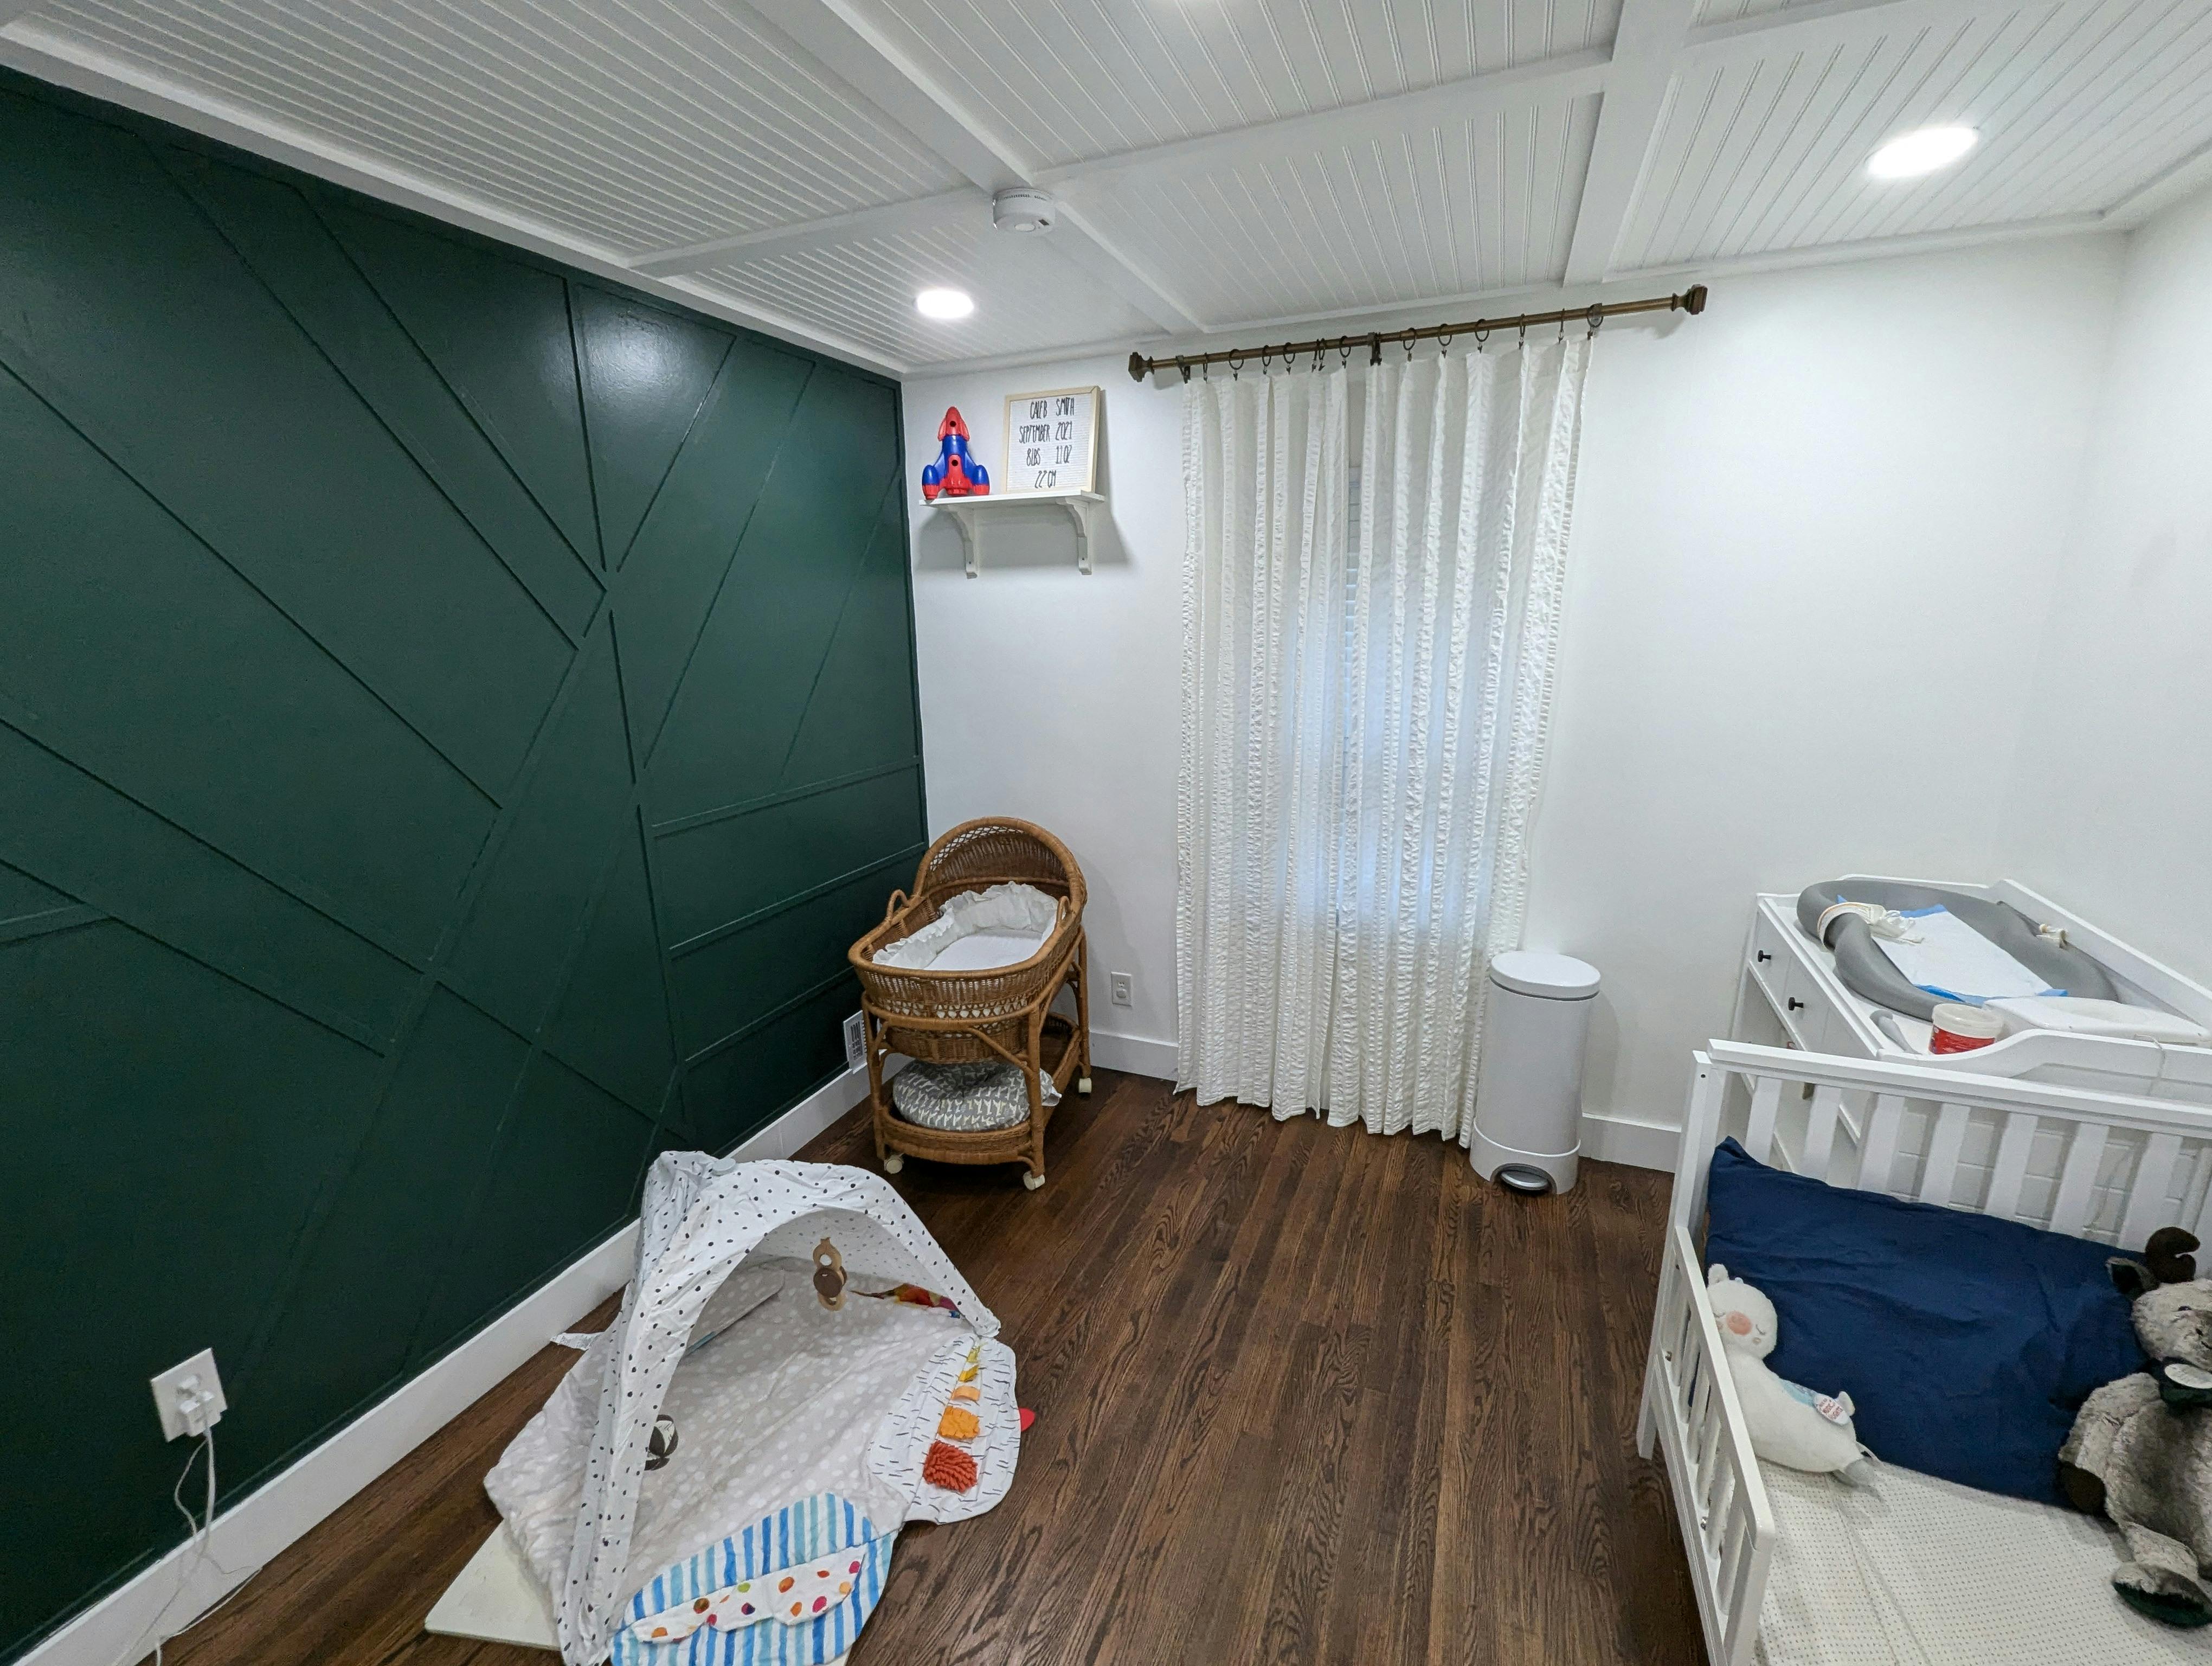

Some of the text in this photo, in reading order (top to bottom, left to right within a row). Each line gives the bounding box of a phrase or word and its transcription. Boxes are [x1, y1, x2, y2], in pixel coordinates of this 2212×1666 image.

[1030, 397, 1075, 419] CALEB SMITH
[1019, 421, 1072, 444] SEPTEMBER 2021
[1026, 448, 1040, 466] 8LBS
